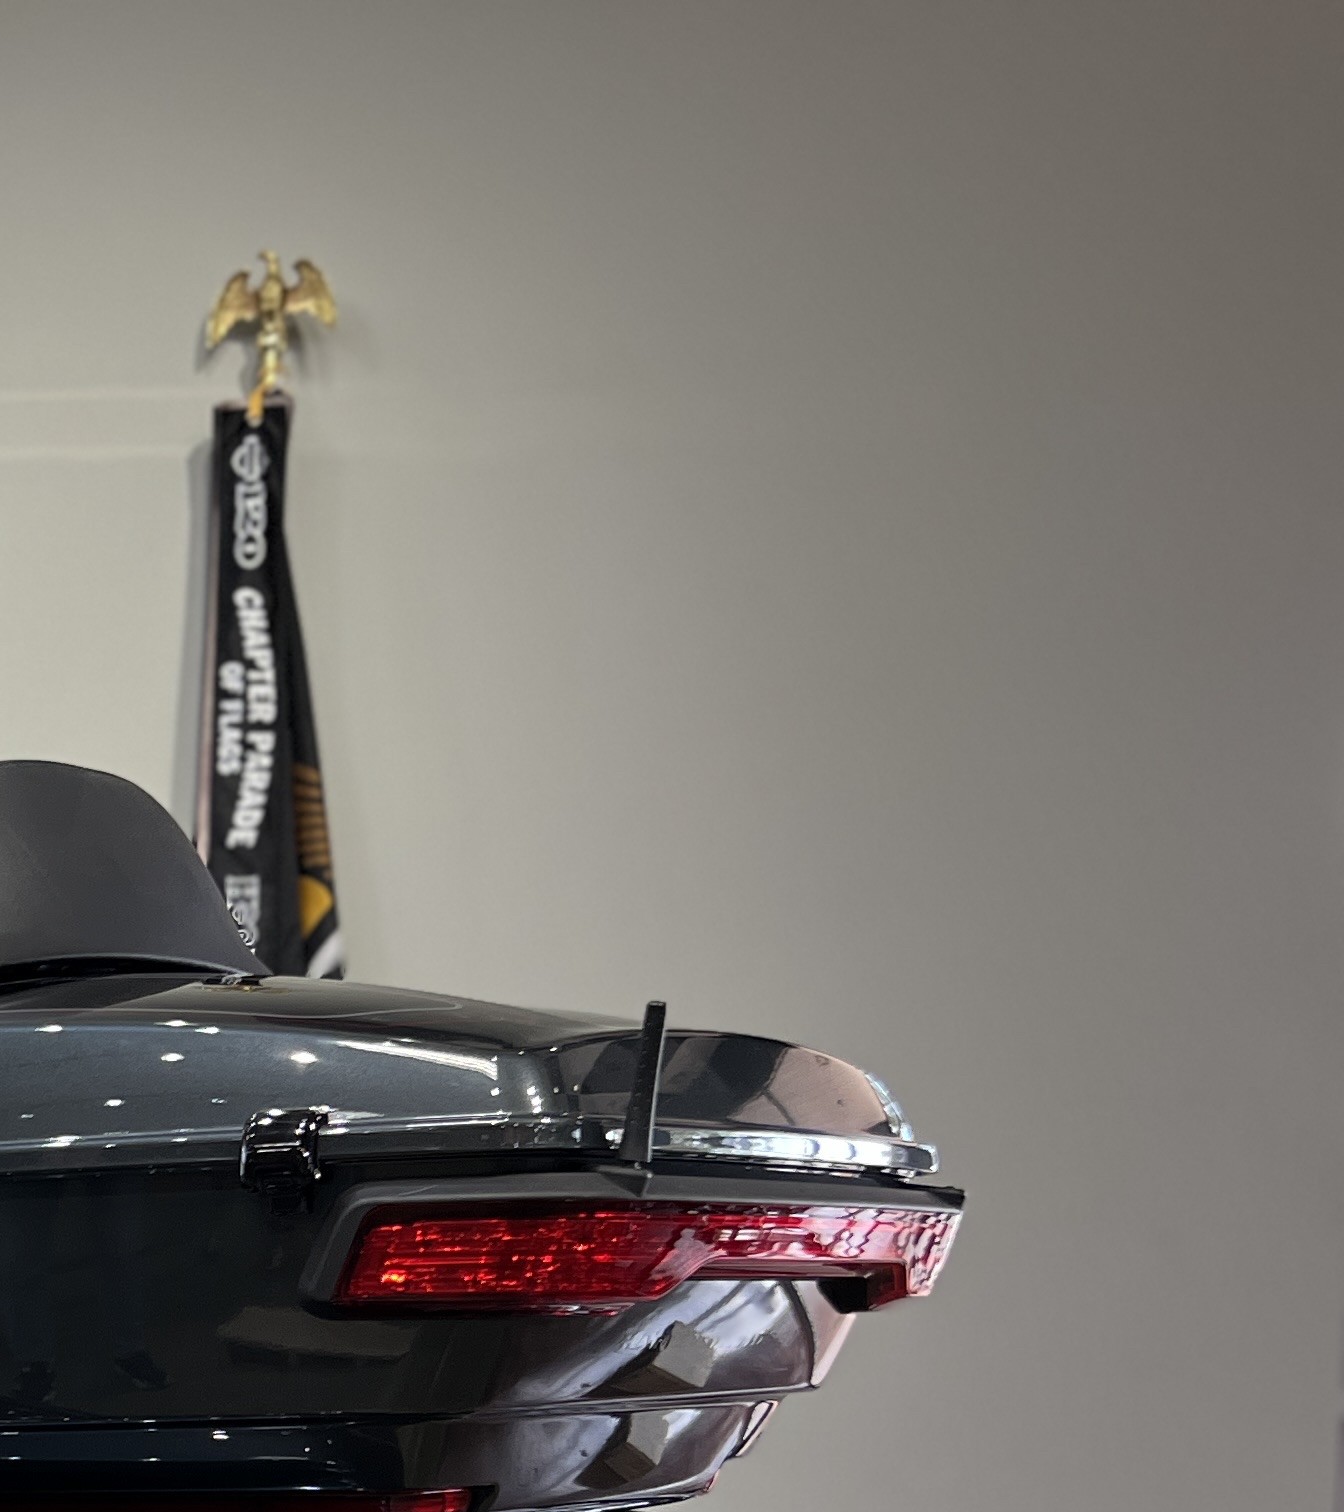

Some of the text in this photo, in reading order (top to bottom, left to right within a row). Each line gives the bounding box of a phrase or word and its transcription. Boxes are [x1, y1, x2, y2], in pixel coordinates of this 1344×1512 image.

[232, 585, 277, 726] CHAPTER
[215, 700, 242, 778] FLAGS
[225, 729, 276, 851] PARADE
